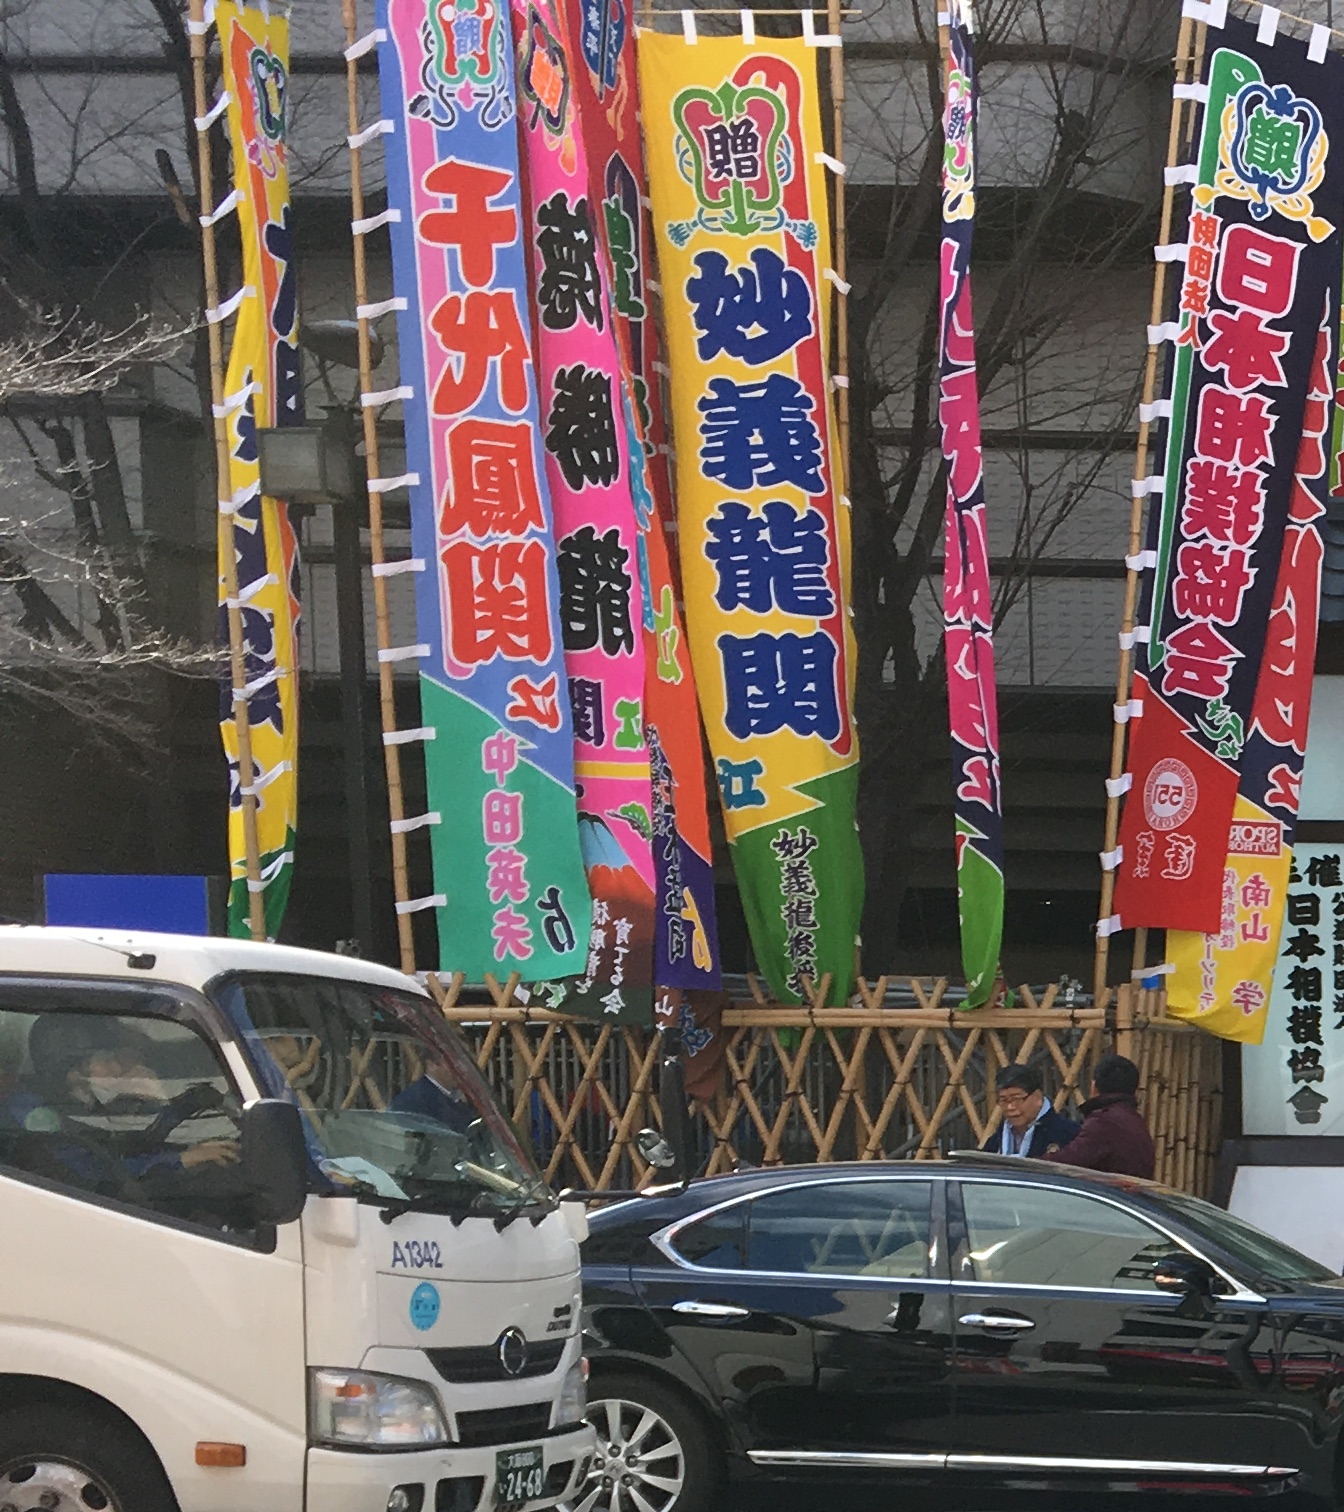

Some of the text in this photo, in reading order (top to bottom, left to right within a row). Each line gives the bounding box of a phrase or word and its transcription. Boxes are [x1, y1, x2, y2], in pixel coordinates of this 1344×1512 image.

[706, 123, 765, 182] 贈
[683, 246, 848, 743] 妙義龍関
[391, 1240, 443, 1268] A1342
